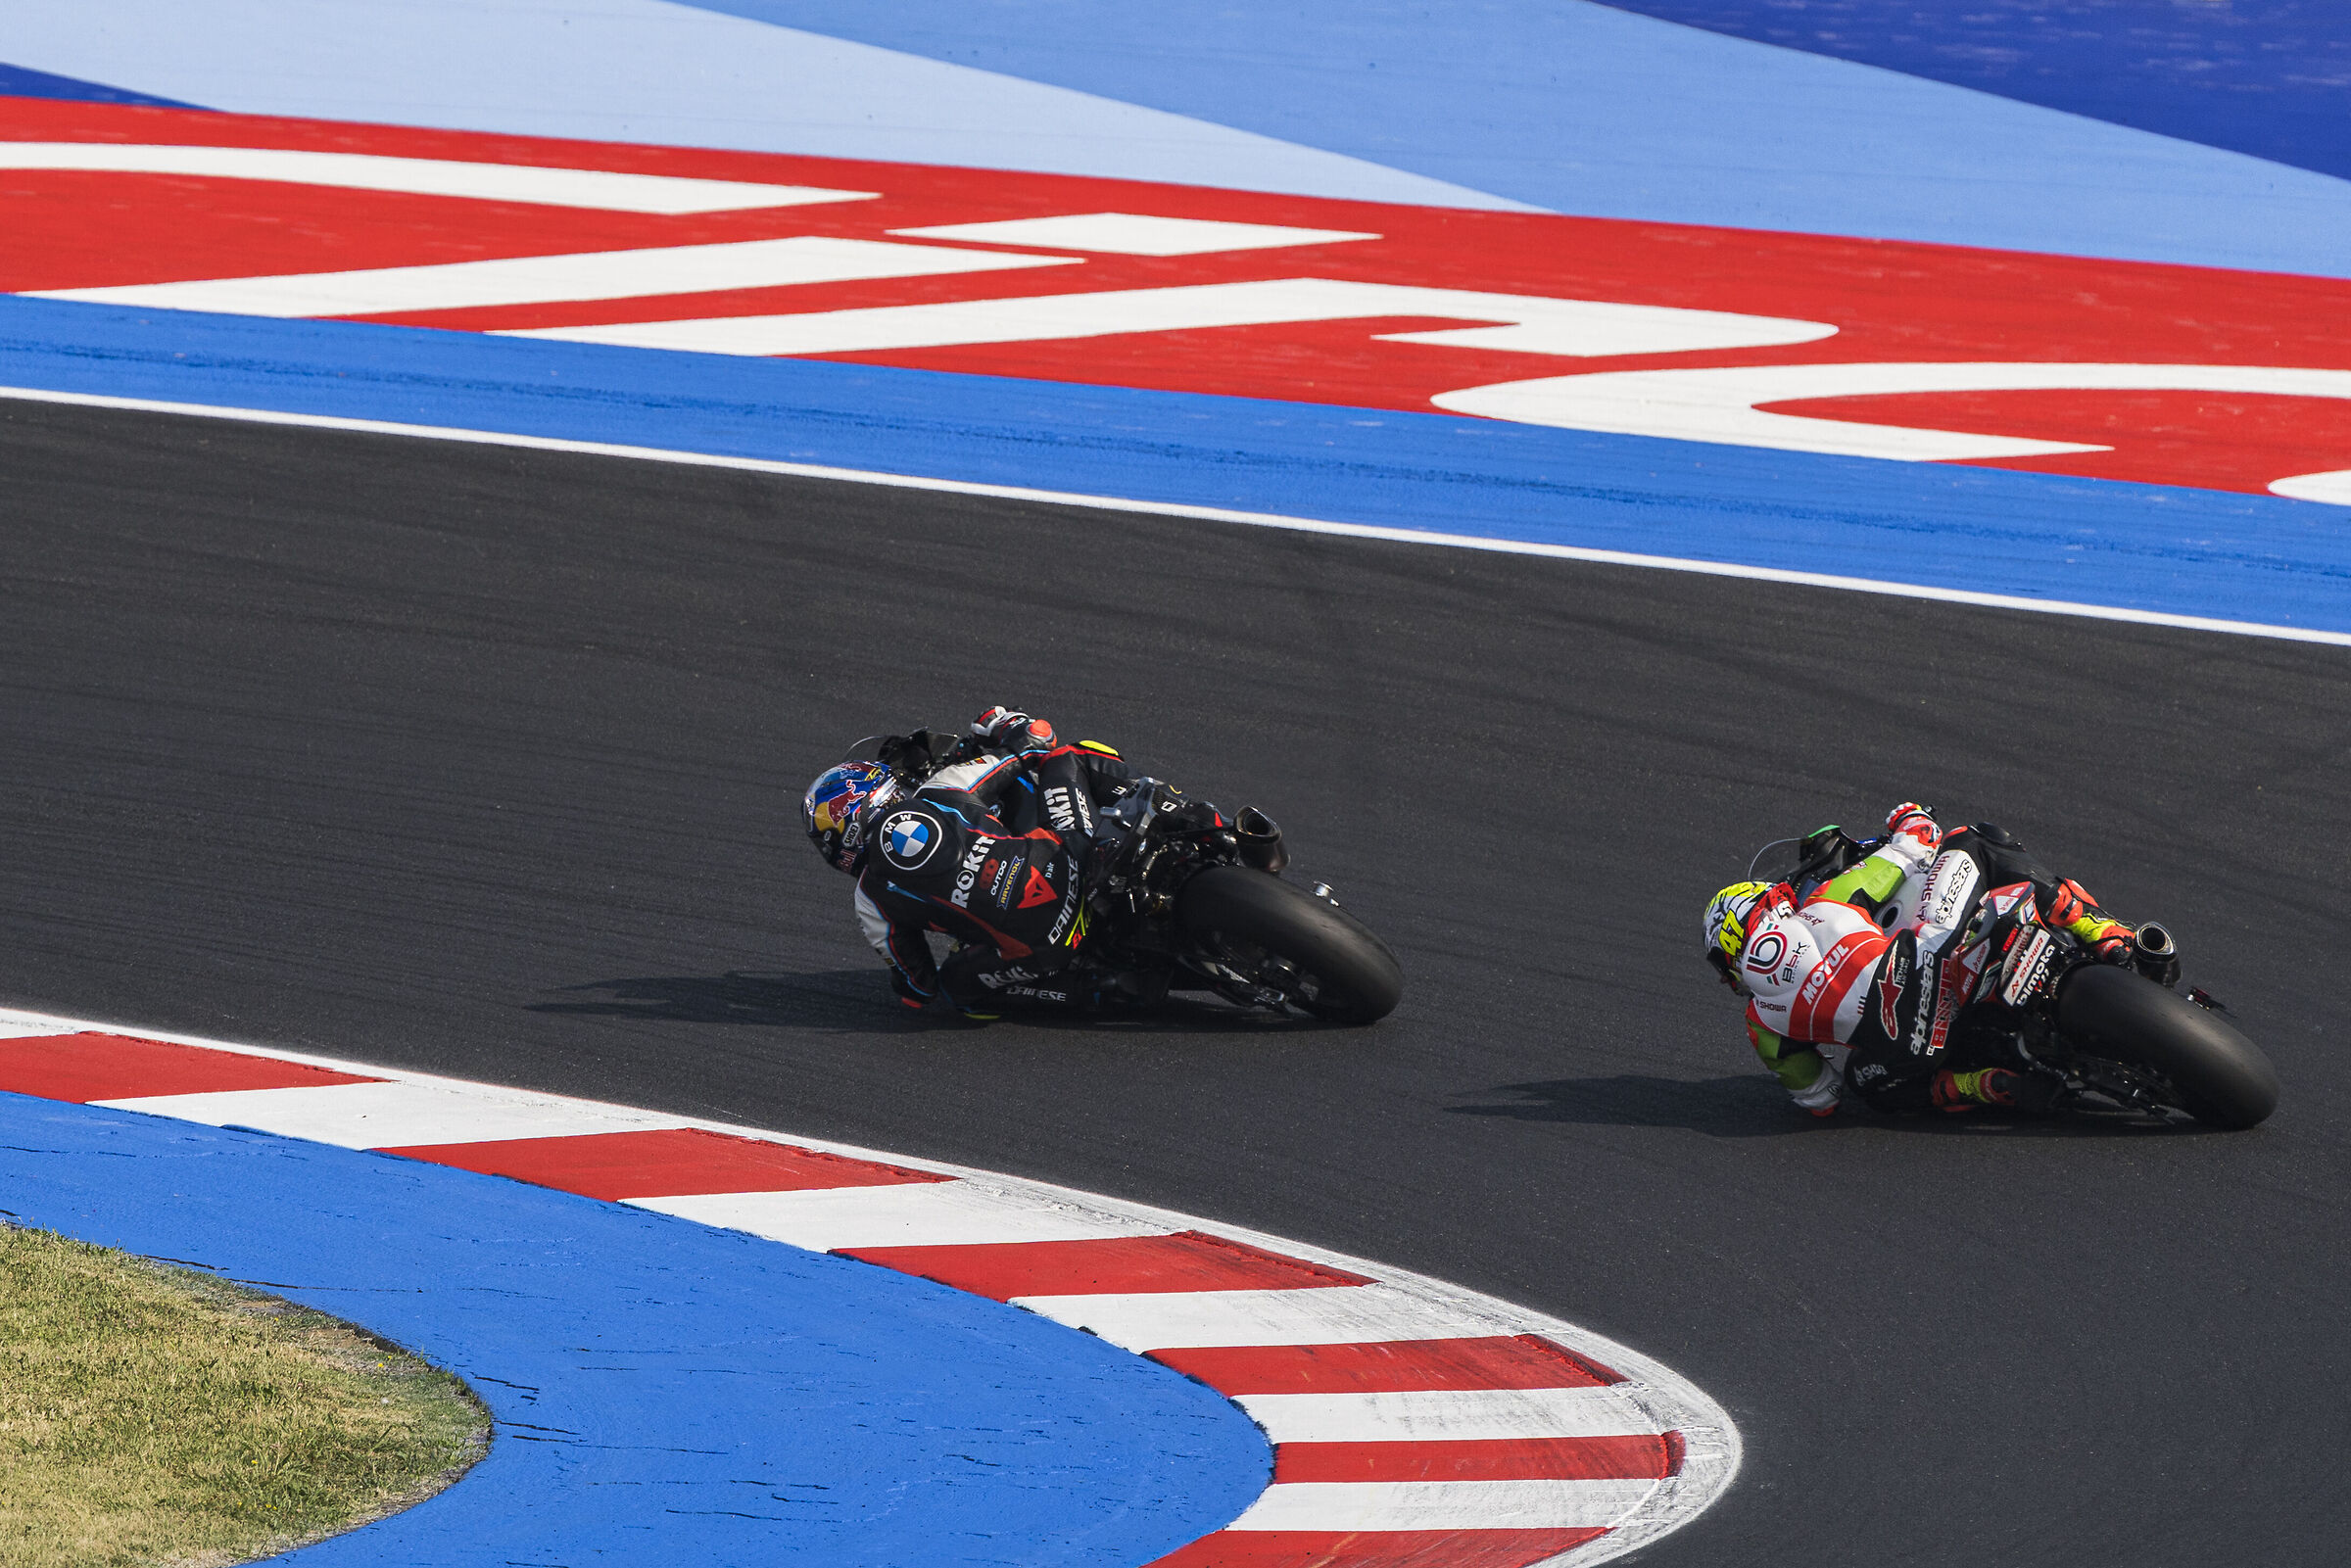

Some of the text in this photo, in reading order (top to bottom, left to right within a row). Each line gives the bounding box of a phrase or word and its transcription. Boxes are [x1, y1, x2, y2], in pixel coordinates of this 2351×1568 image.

[844, 825, 859, 844] SHOEI
[885, 813, 912, 852] BMW
[951, 836, 997, 908] ROKiT
[990, 860, 1008, 896] OUTDO
[1000, 858, 1021, 905] RAVENOL
[1921, 855, 1950, 902] SHOWA
[1936, 858, 1973, 925] alpinestars
[1047, 854, 1079, 945] DAINESE
[1719, 909, 1745, 957] 47
[1801, 943, 1849, 1006] MOTUL
[2017, 944, 2055, 1006] bimota
[2019, 937, 2044, 978] SHOWA
[1910, 949, 1935, 1056] alpinestars
